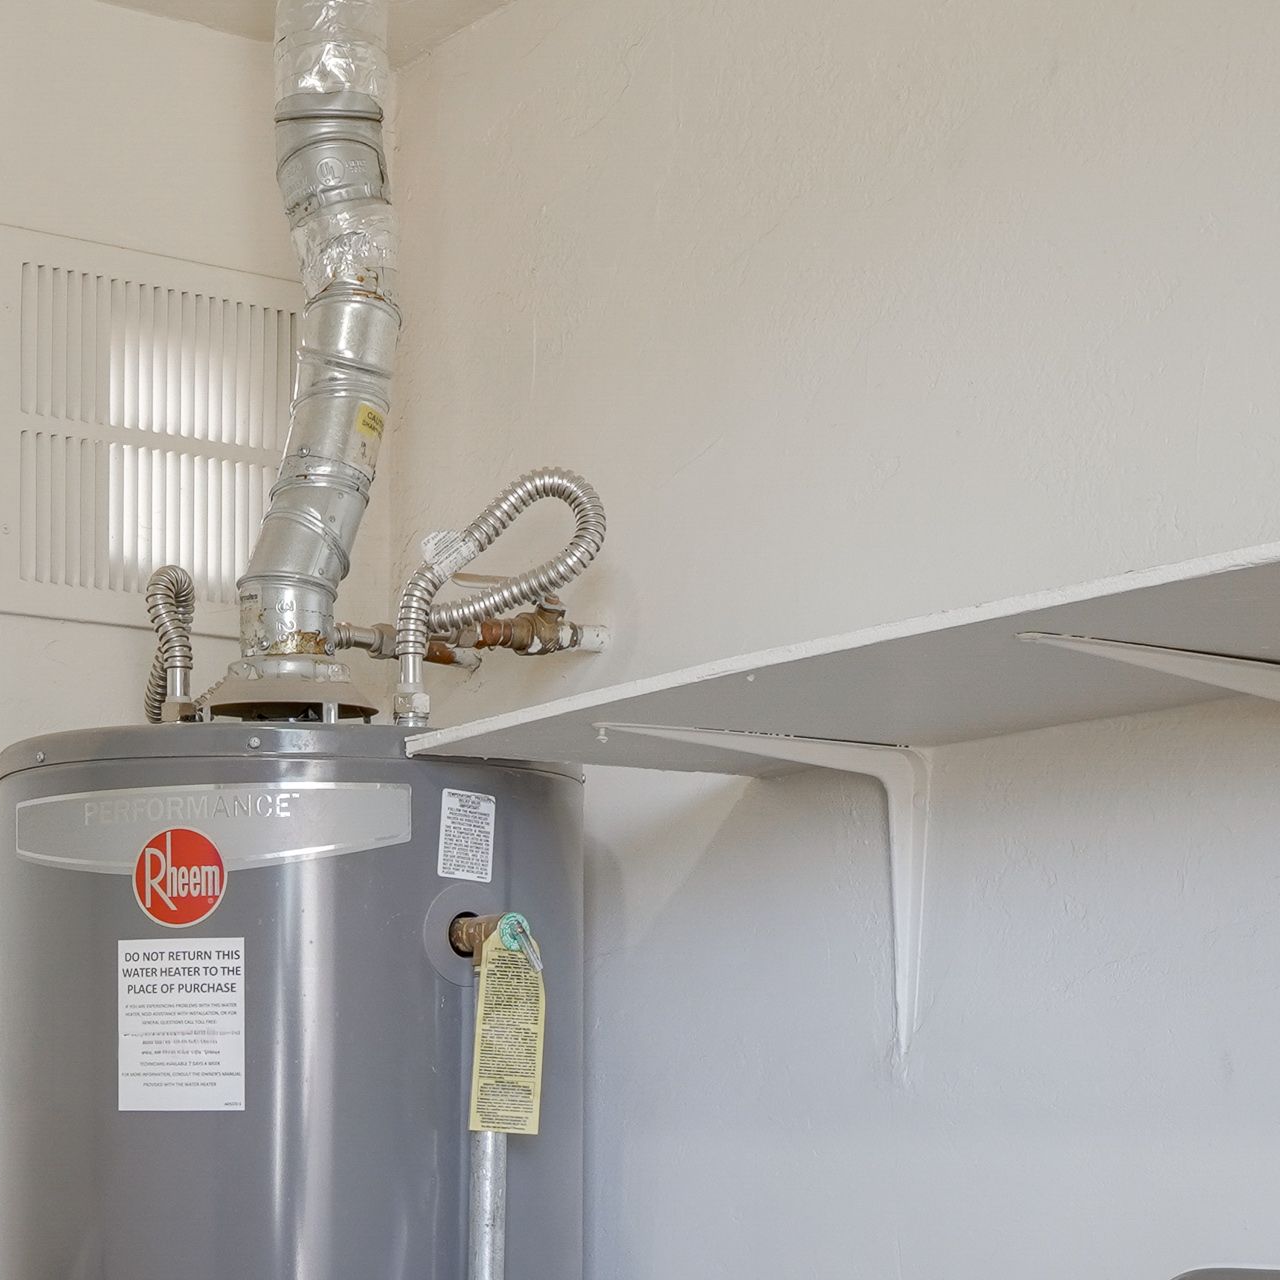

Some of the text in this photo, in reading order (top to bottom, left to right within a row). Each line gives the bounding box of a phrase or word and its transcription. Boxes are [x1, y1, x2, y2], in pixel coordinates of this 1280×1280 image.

[84, 793, 291, 825] PERFORMANCE
[145, 831, 220, 911] Rheem
[125, 950, 240, 962] DO NOT RETURN THIS
[122, 966, 241, 977] WATER HEATER TO THE
[128, 983, 236, 994] PLACE OF PURCHASE
